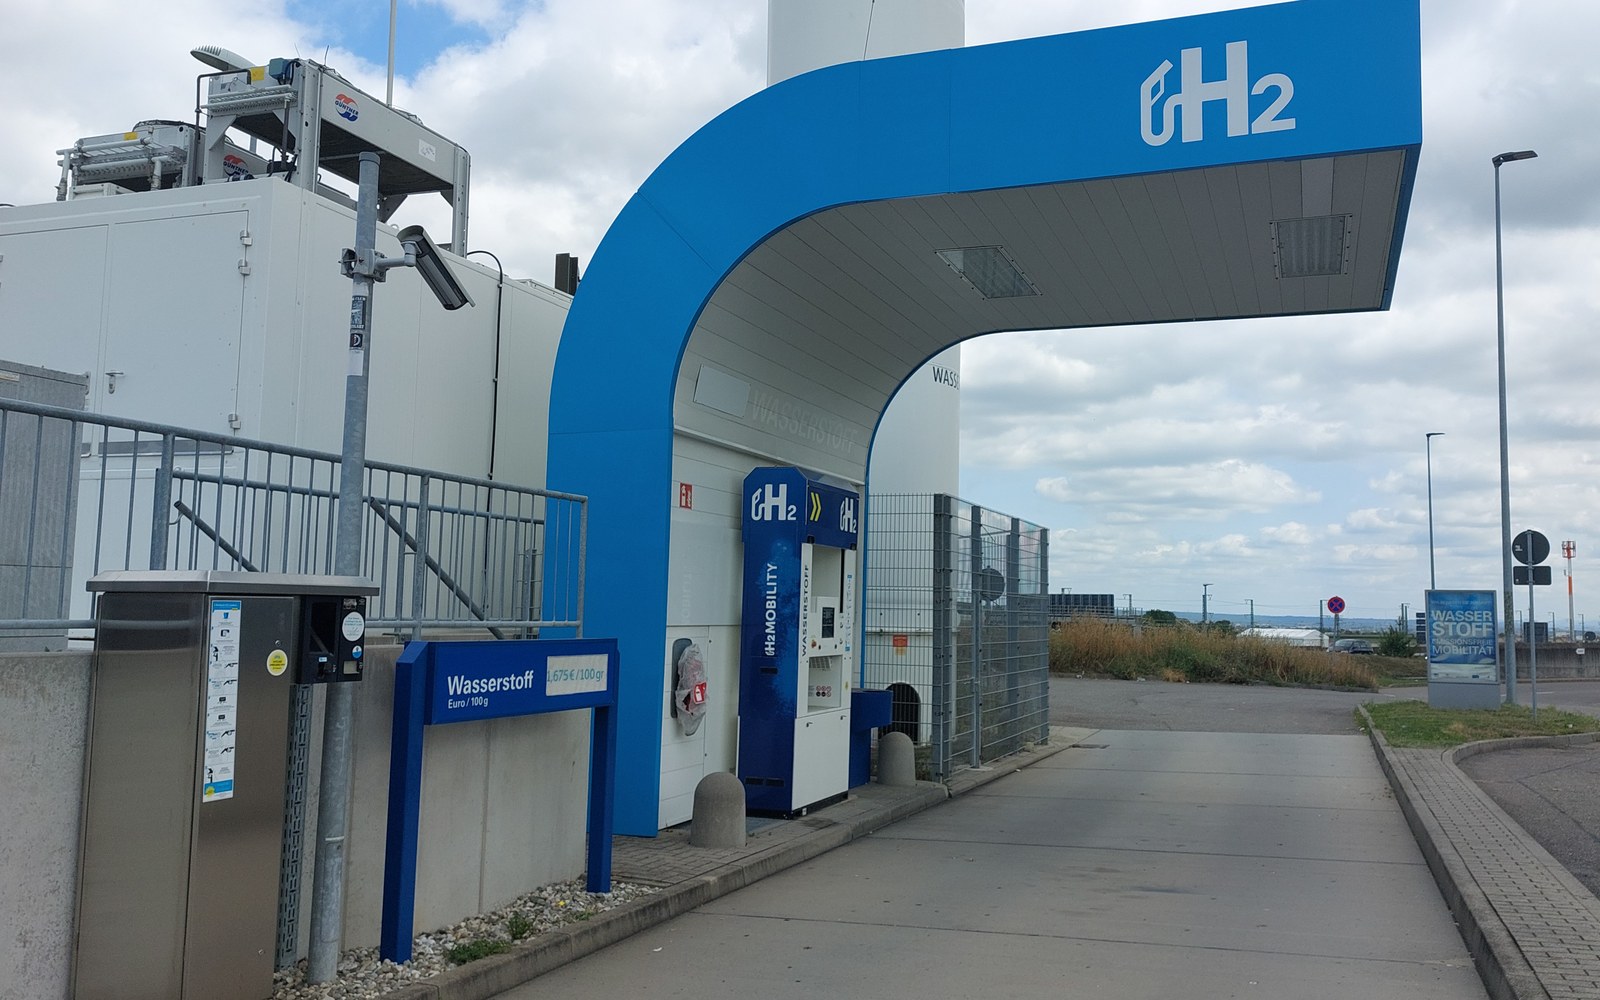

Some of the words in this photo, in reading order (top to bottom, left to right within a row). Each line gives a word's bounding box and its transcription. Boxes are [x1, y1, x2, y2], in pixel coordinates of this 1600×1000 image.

[752, 389, 857, 454] WASSERSTOFF
[801, 564, 809, 657] WASSERSTOFF
[1431, 610, 1492, 622] WASSER
[1432, 622, 1493, 637] STOFF
[1432, 644, 1493, 656] MOBILITÄT
[447, 671, 534, 696] Wasserstoff
[448, 698, 466, 709] Euro
